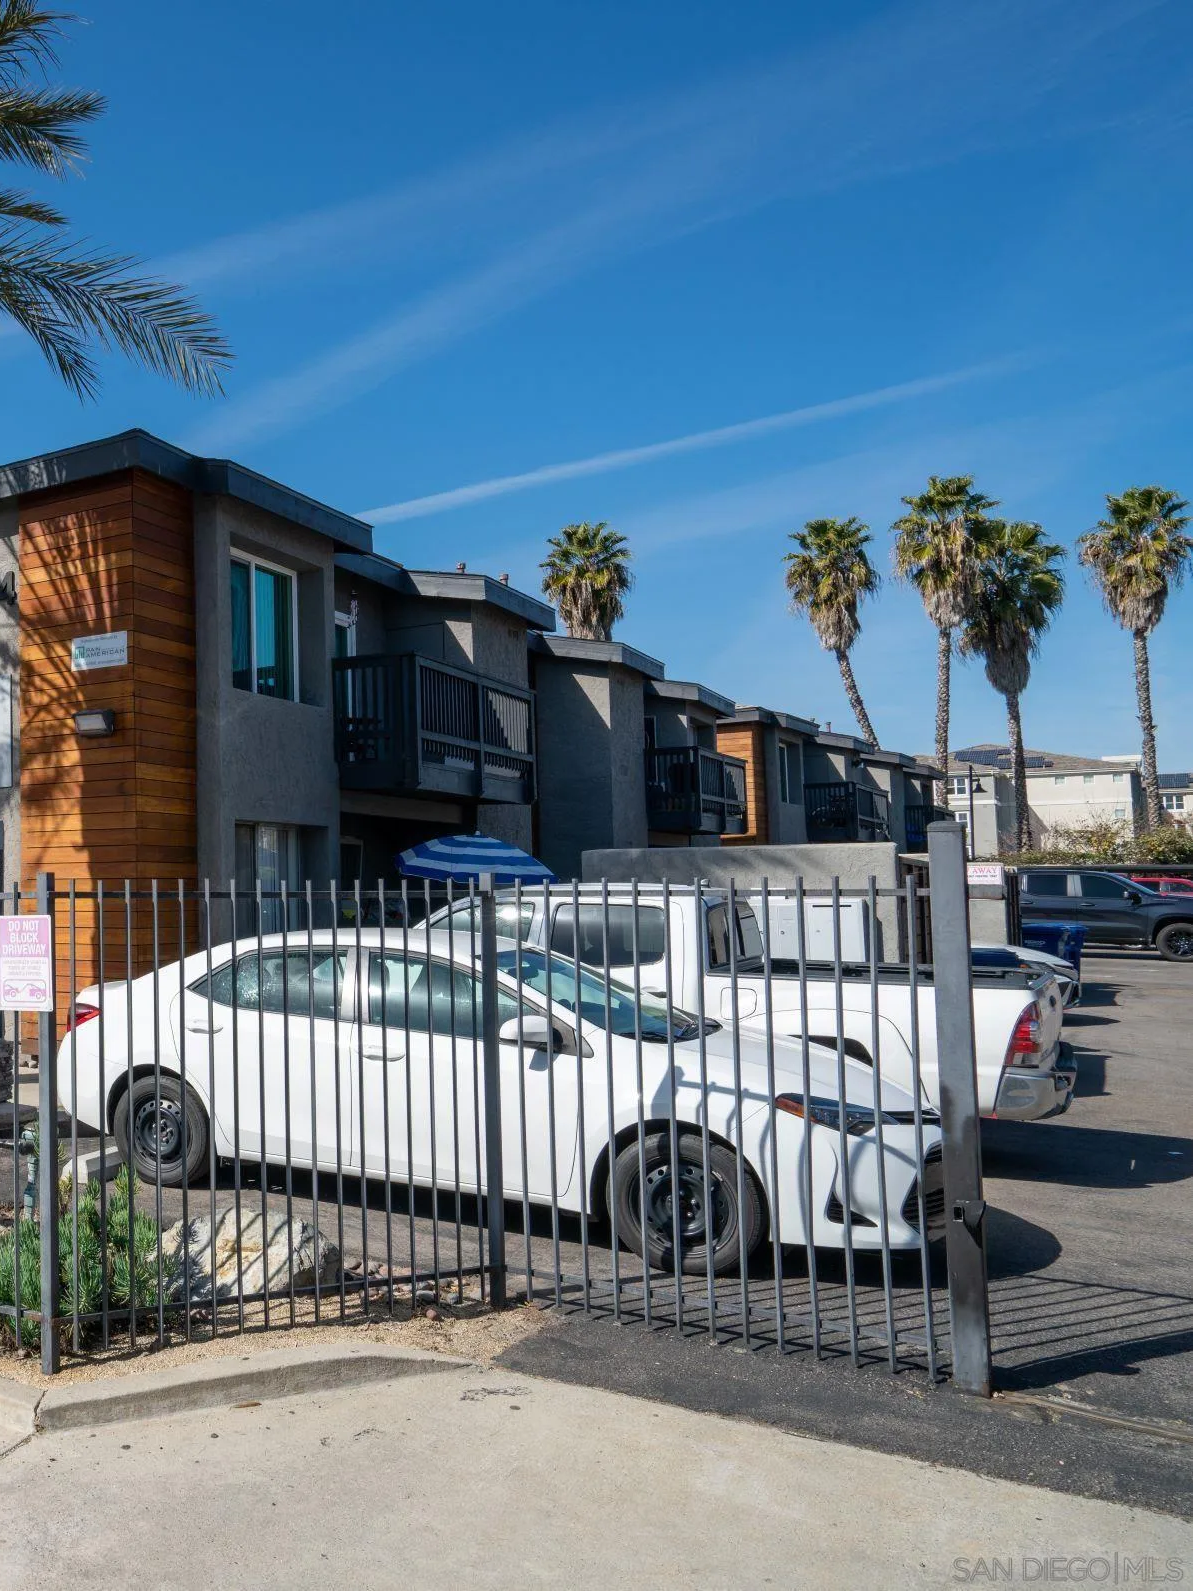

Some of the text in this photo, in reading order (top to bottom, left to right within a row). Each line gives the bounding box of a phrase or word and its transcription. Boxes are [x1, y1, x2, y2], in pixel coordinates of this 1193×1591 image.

[86, 647, 125, 658] AMERICAN
[8, 920, 40, 931] DO NOT
[9, 932, 39, 944] BLOCK
[2, 943, 47, 955] DRIVEWAY
